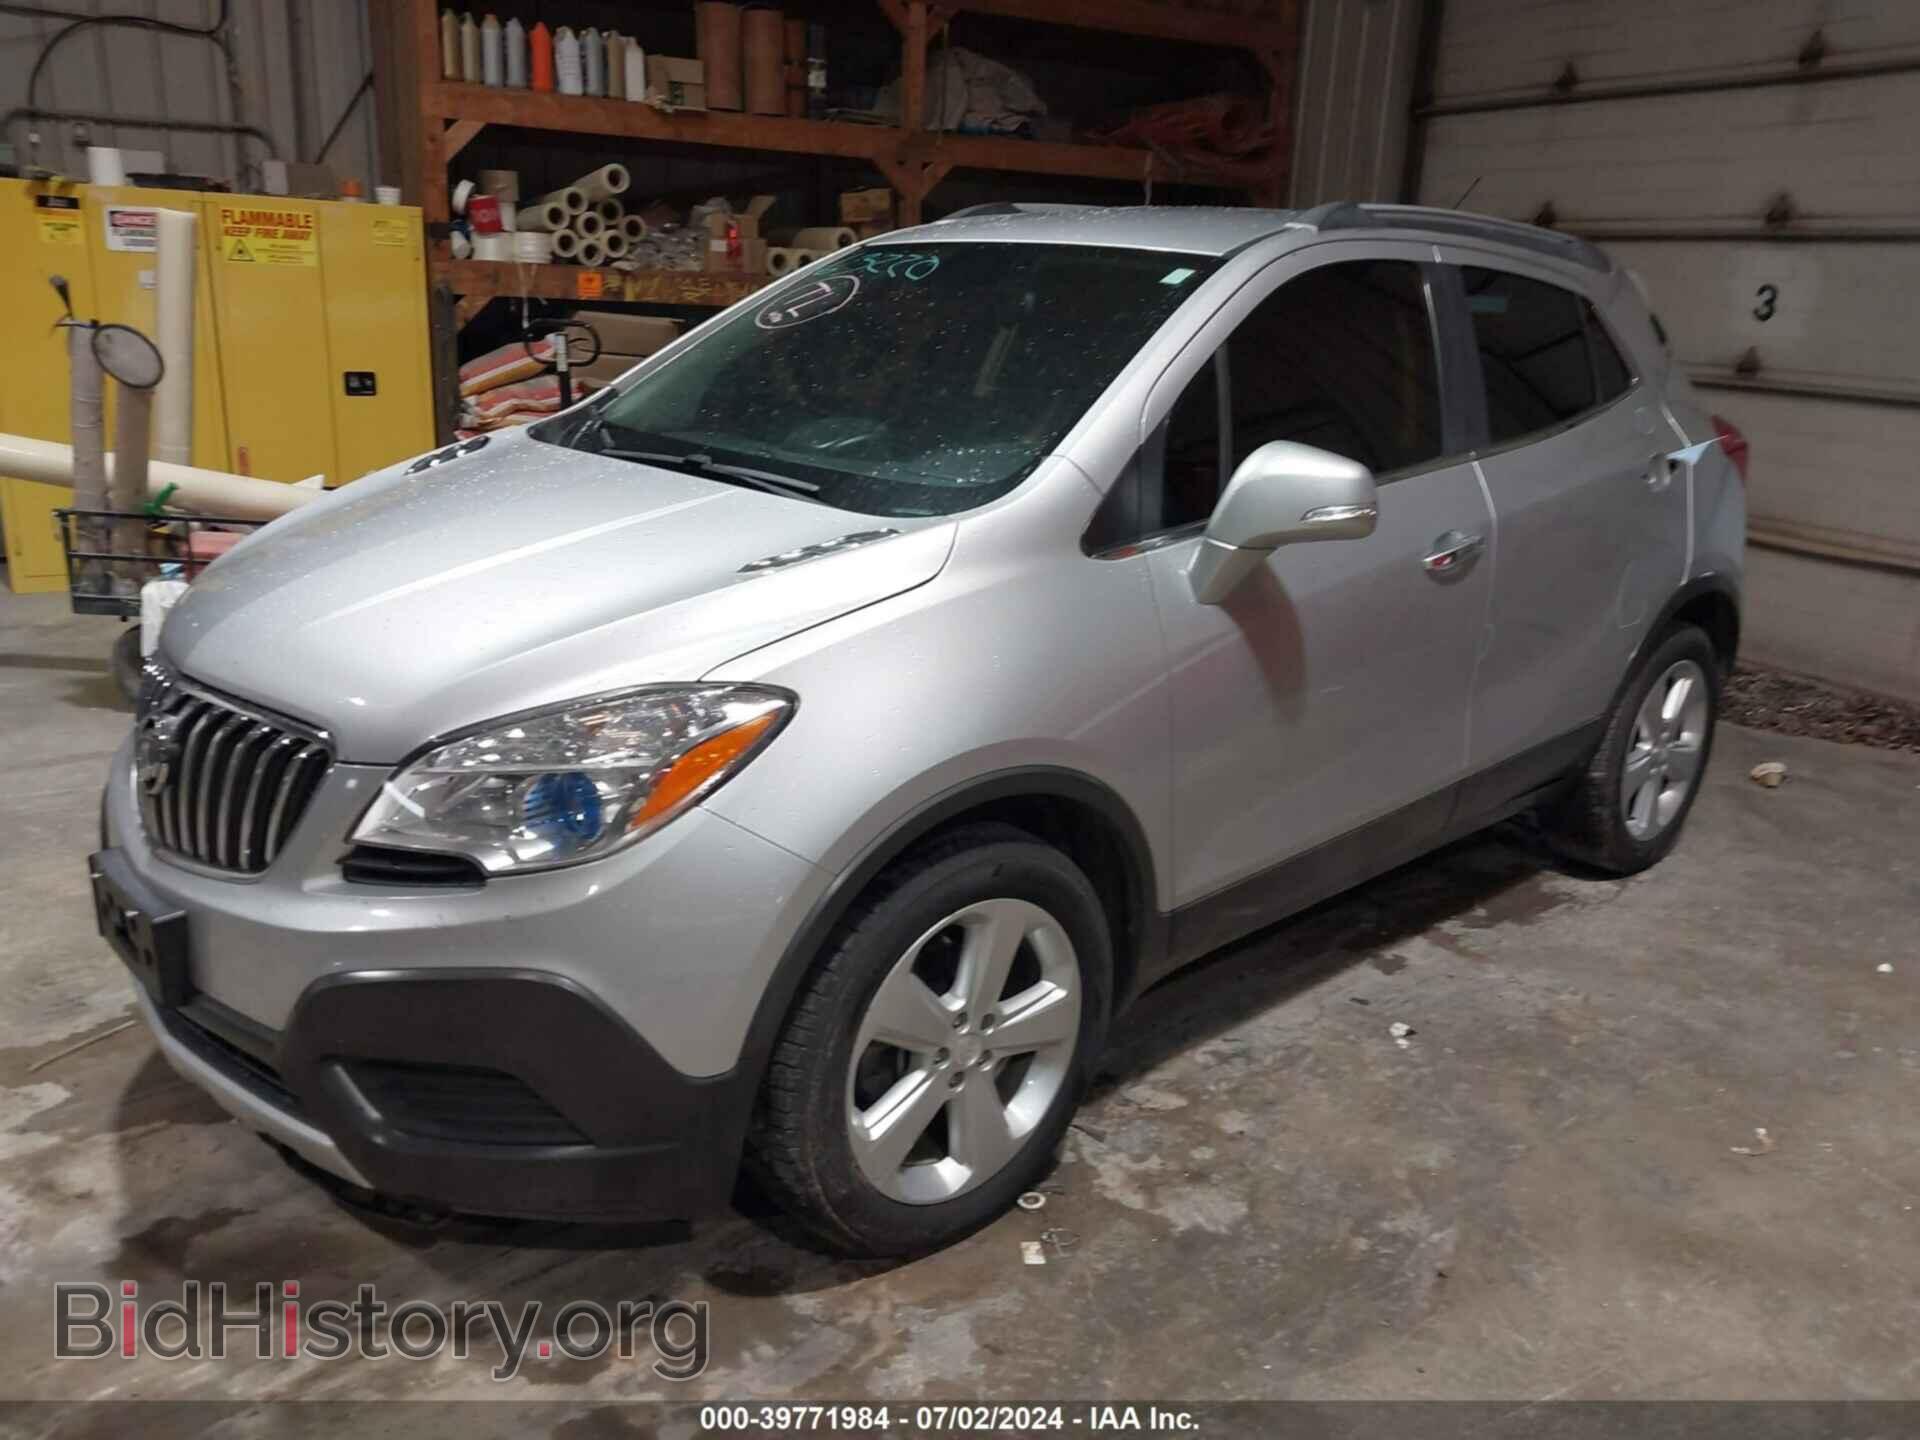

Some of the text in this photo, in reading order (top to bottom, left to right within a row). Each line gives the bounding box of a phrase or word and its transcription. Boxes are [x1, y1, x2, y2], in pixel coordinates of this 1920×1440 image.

[221, 209, 313, 229] FLAMMABLE
[224, 226, 251, 237] KEEP
[1752, 284, 1779, 322] 3
